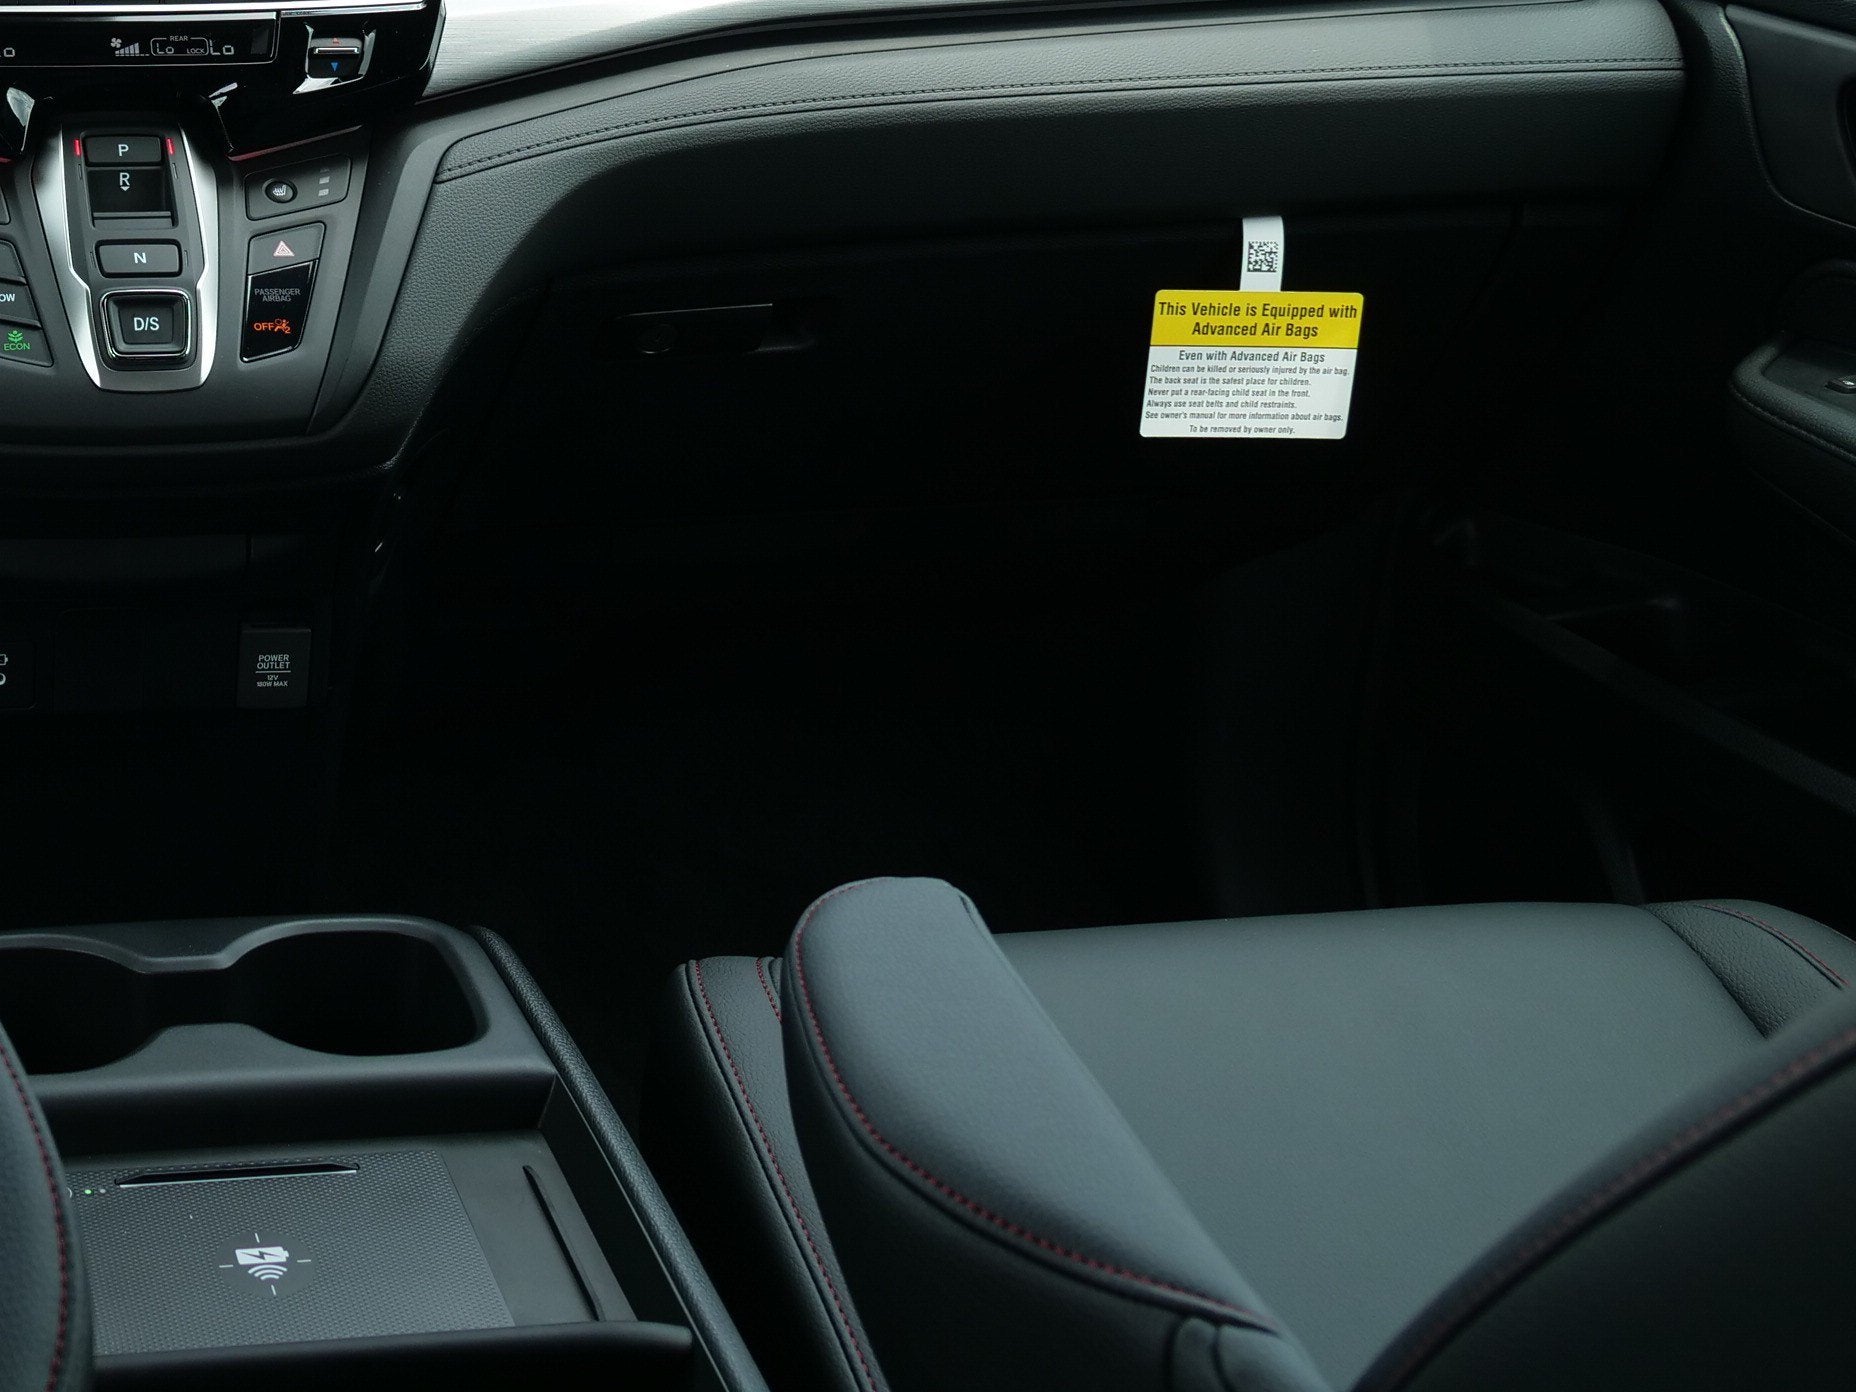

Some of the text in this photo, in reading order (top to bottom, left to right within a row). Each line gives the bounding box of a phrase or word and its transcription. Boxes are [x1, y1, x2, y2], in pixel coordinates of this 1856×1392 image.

[186, 47, 205, 55] LOCK
[118, 144, 129, 157] P
[119, 172, 130, 186] R
[133, 252, 147, 264] N
[254, 288, 301, 296] PASSENGER
[1158, 301, 1357, 320] This Vehicle is Equipped with
[133, 317, 160, 331] D/S
[253, 322, 274, 331] OFF
[1191, 322, 1319, 339] Advanced Air Bags
[3, 343, 31, 351] ECON
[1178, 350, 1325, 364] Even with Advanced Air Bags
[1151, 364, 1180, 373] Children
[1196, 365, 1205, 373] be
[1206, 365, 1227, 373] killed
[1237, 366, 1271, 375] seriously
[1271, 366, 1297, 375] injured
[1298, 367, 1307, 375] by
[1322, 367, 1333, 375] air
[1334, 367, 1350, 376] bag.
[1189, 424, 1197, 433] To
[1199, 425, 1208, 433] be
[1210, 425, 1242, 433] removed
[1243, 425, 1252, 434] by
[1277, 426, 1295, 435] only.
[258, 654, 290, 662] POWER
[256, 661, 291, 669] OUTLET
